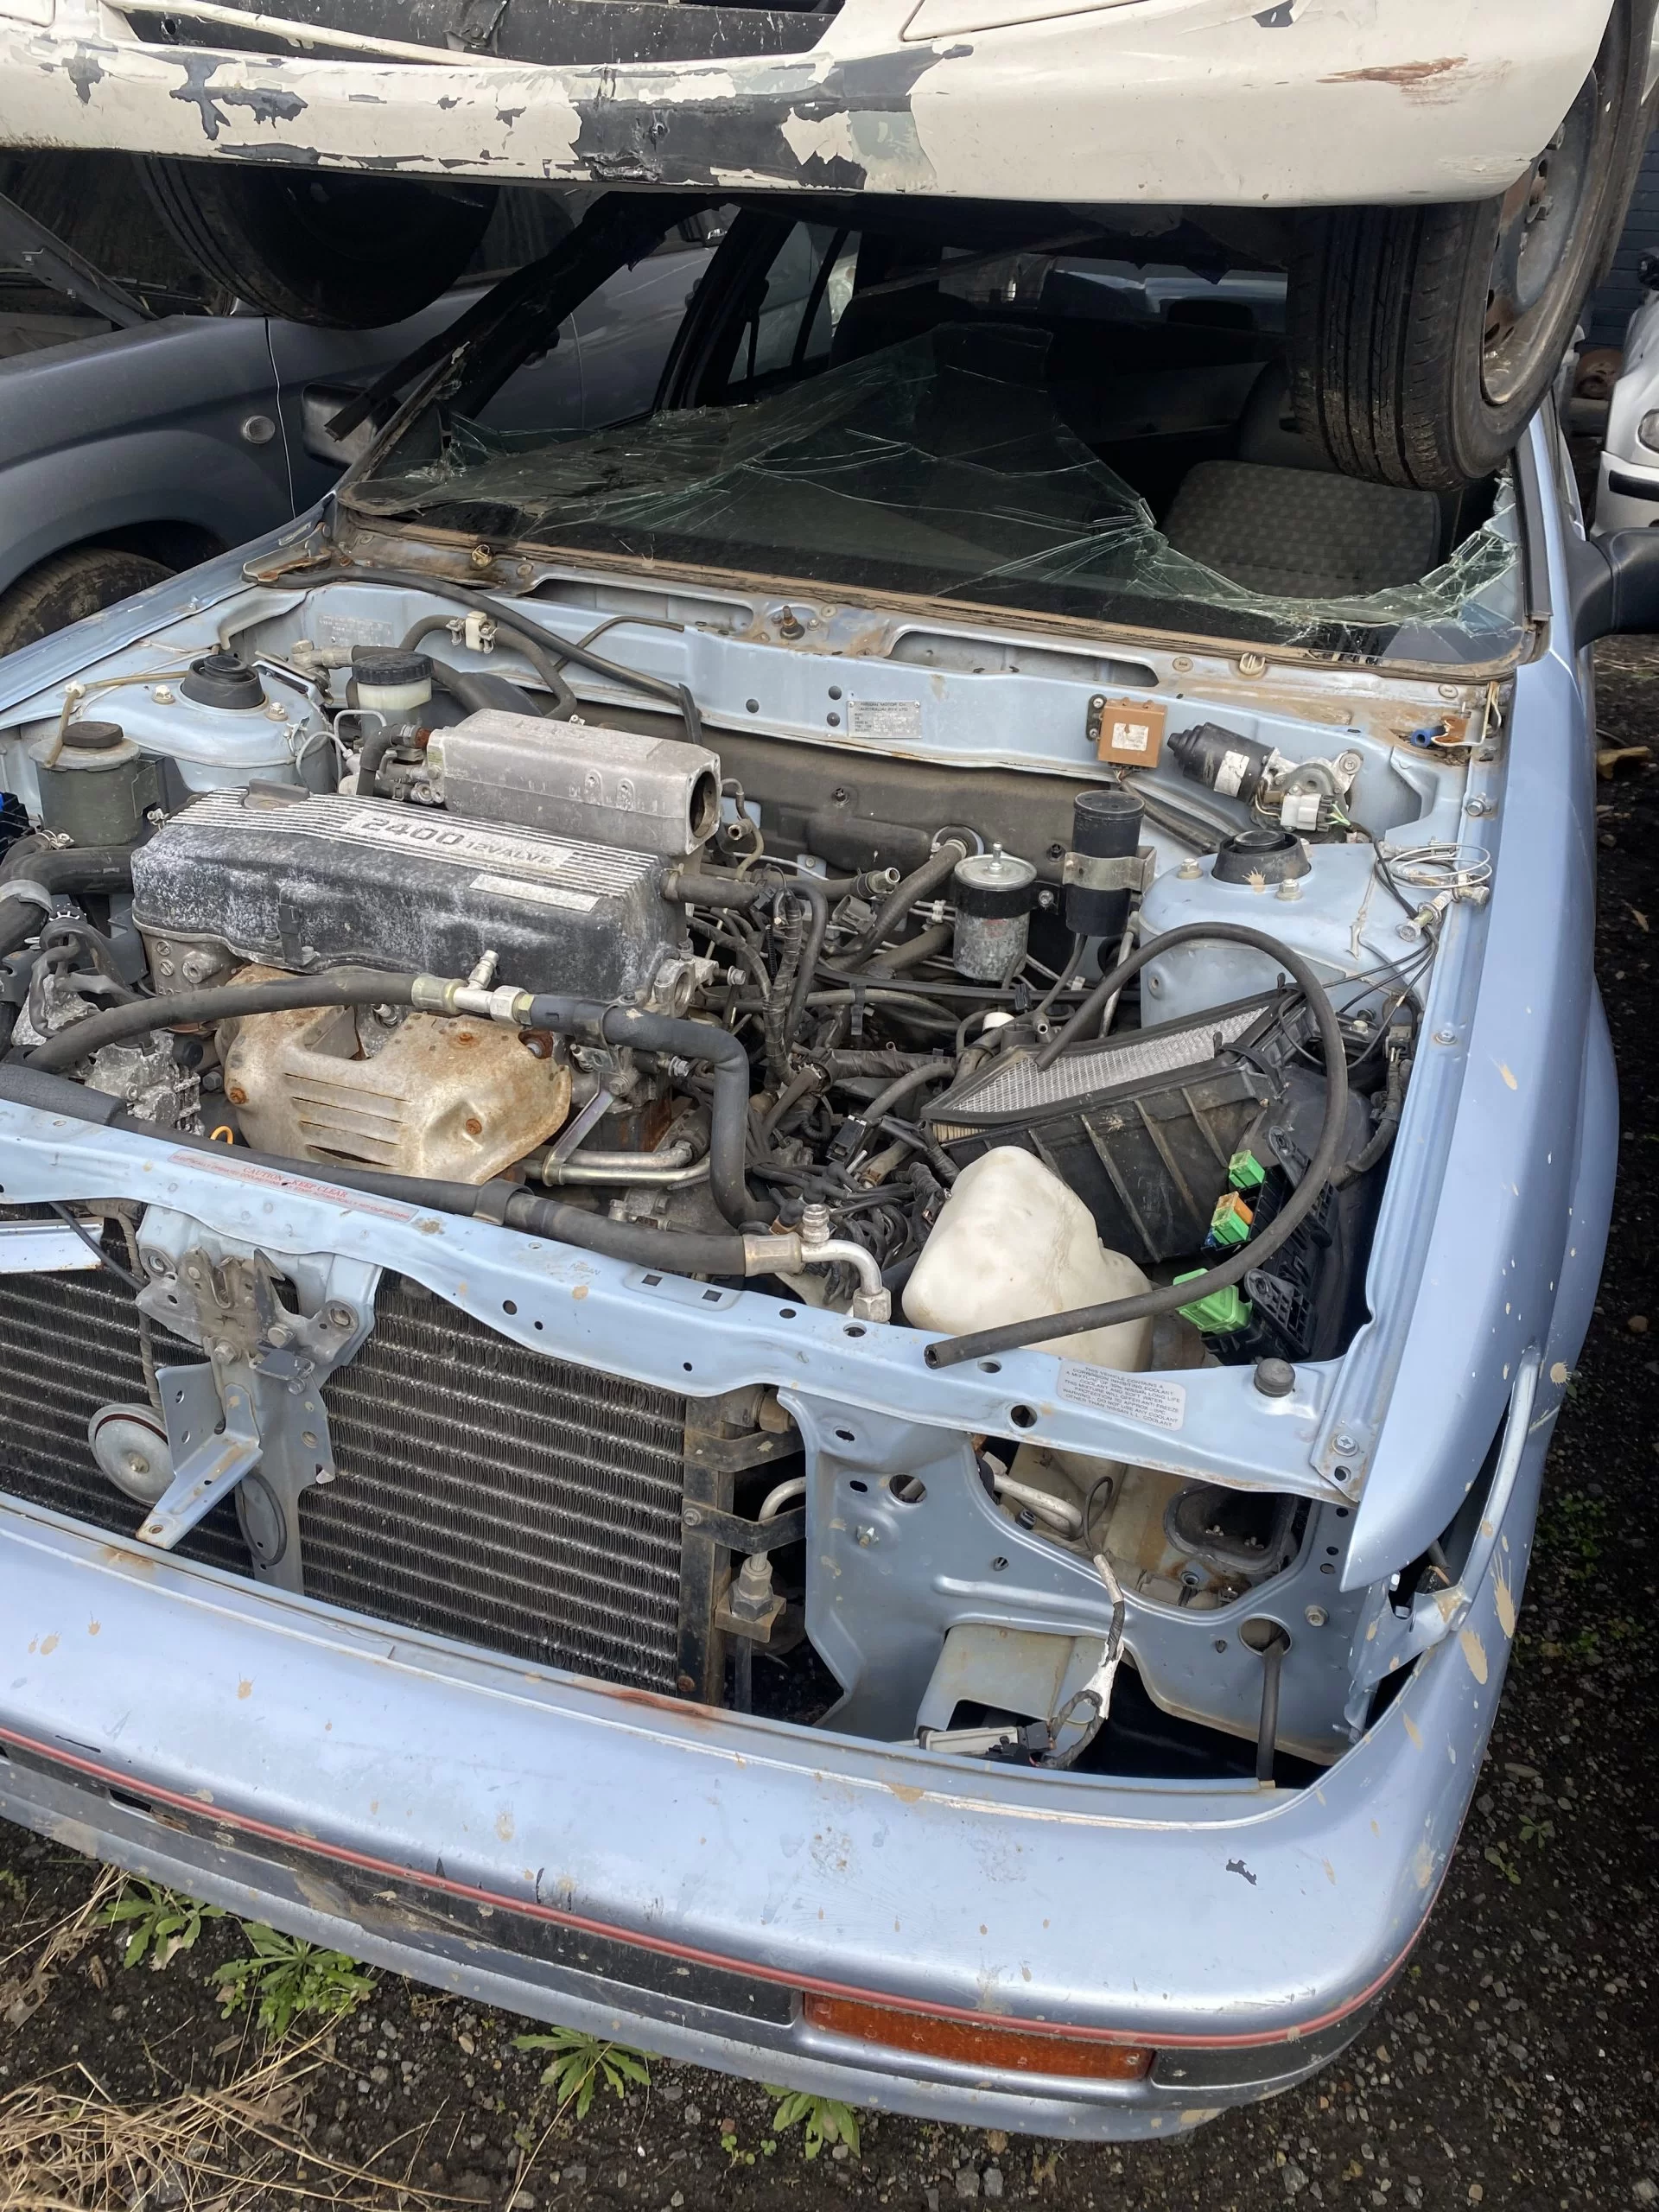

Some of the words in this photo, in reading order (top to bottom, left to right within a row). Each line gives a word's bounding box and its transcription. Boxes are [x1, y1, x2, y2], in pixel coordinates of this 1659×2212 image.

[360, 817, 464, 846] 2400
[243, 1166, 283, 1180] CAUTION
[291, 1179, 315, 1189] KEEP
[317, 1185, 347, 1197] CLEAR
[1071, 1368, 1109, 1381] CORROSION
[1110, 1377, 1142, 1389] INHIBITING
[1144, 1385, 1173, 1396] COOLANT
[1071, 1372, 1097, 1382] MIXTURE
[1123, 1386, 1147, 1395] NISSAN
[1074, 1387, 1112, 1400] PROTECTION
[1079, 1378, 1108, 1389] COOLANT
[1142, 1395, 1163, 1403] WATER
[1099, 1370, 1125, 1381] VEHICLE
[1126, 1376, 1157, 1389] CONTAINS
[1062, 1388, 1090, 1399] WARNING
[1147, 1411, 1178, 1423] COOLANT
[1065, 1393, 1087, 1402] OTHER
[1106, 1404, 1128, 1414] NISSAN
[1142, 1414, 1172, 1427] COOLANT
[1077, 1382, 1104, 1393] MIXTURE
[1120, 1394, 1141, 1402] OFFER
[1155, 1403, 1178, 1413] FREEZE
